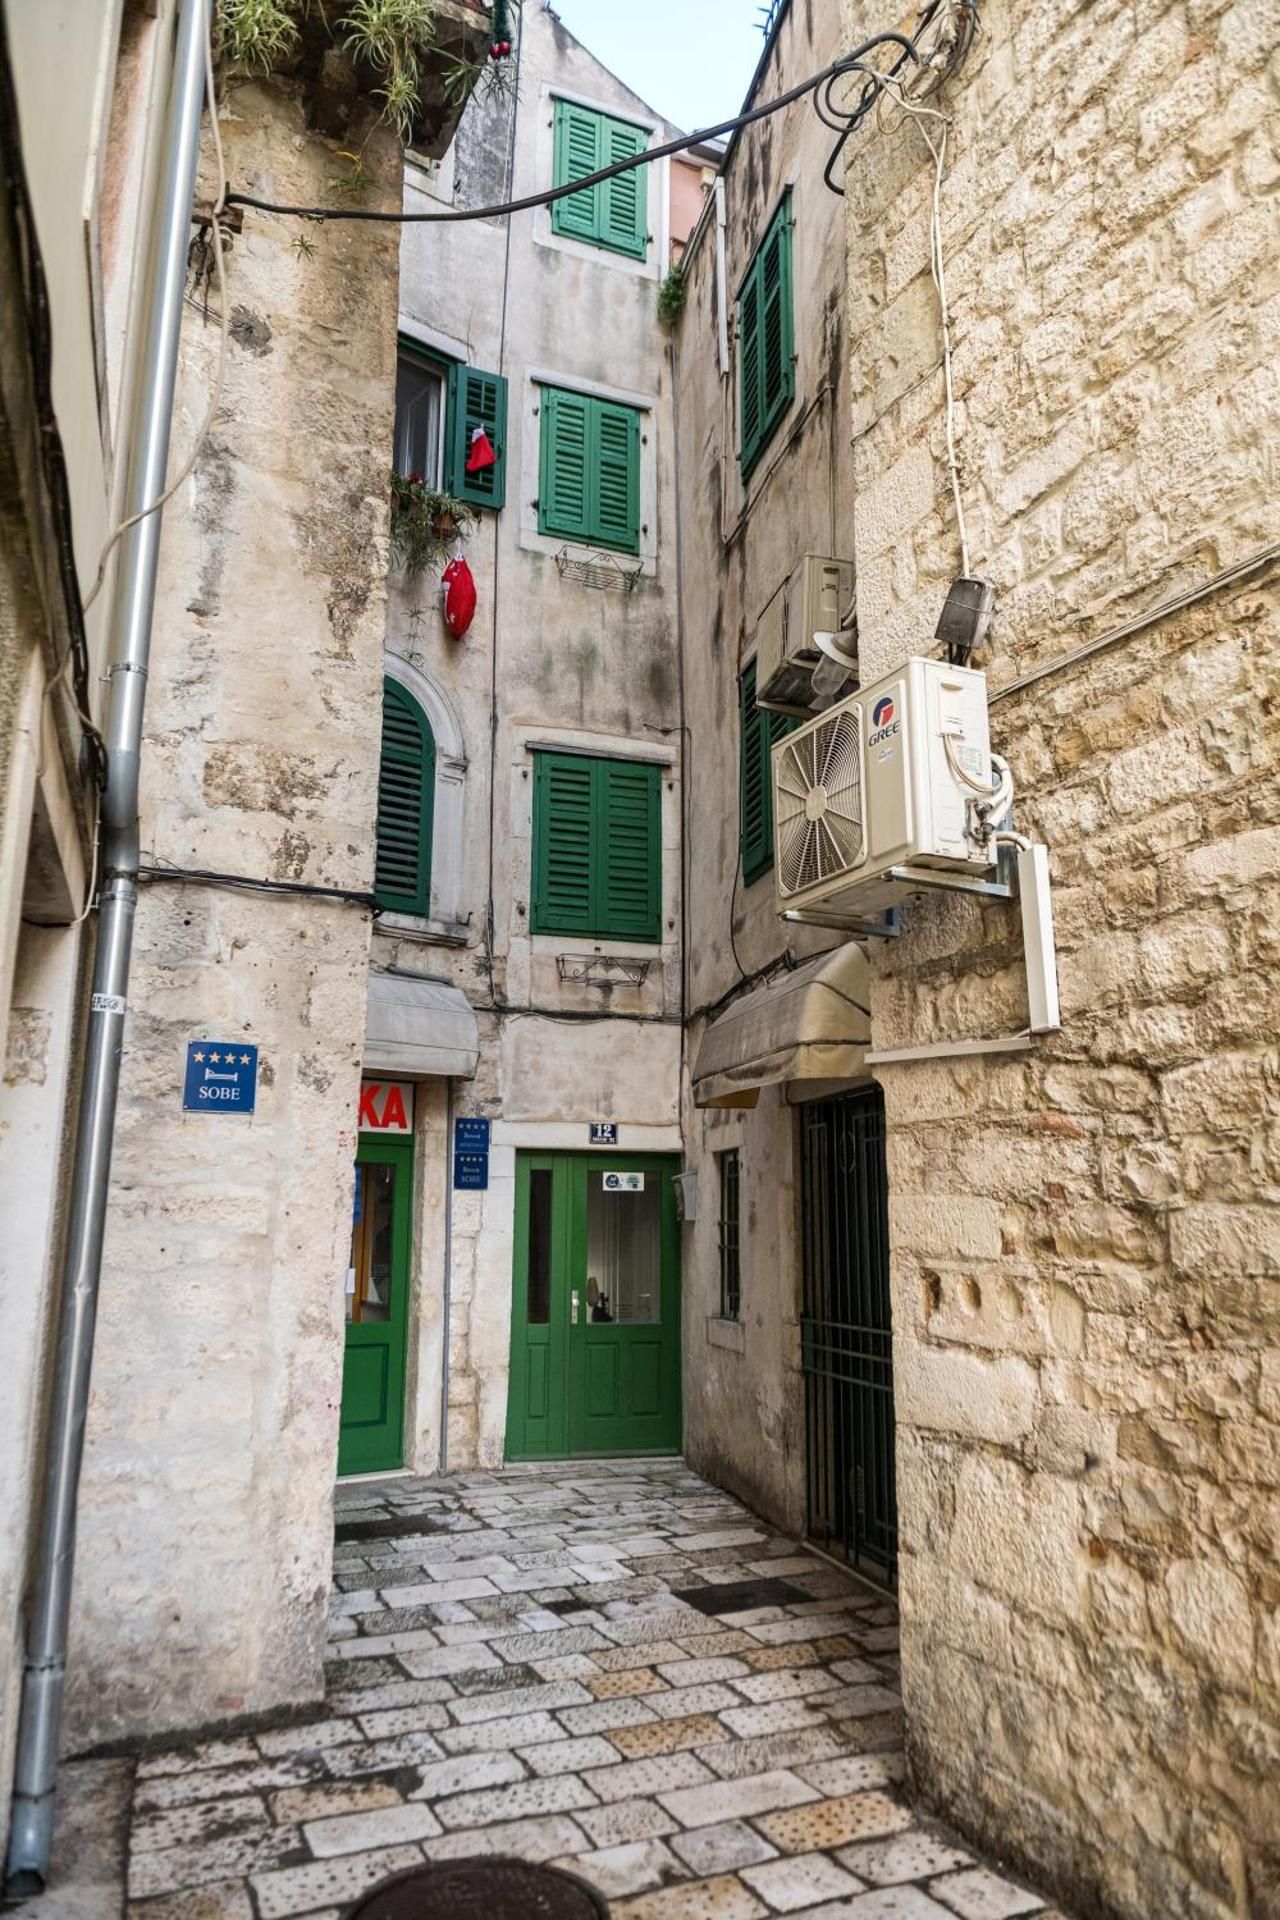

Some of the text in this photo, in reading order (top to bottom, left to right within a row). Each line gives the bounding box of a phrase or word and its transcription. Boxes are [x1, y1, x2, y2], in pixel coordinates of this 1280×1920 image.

[869, 720, 901, 747] GREE
[199, 1086, 240, 1100] SOBE
[359, 1084, 407, 1129] KA
[597, 1124, 612, 1137] 12
